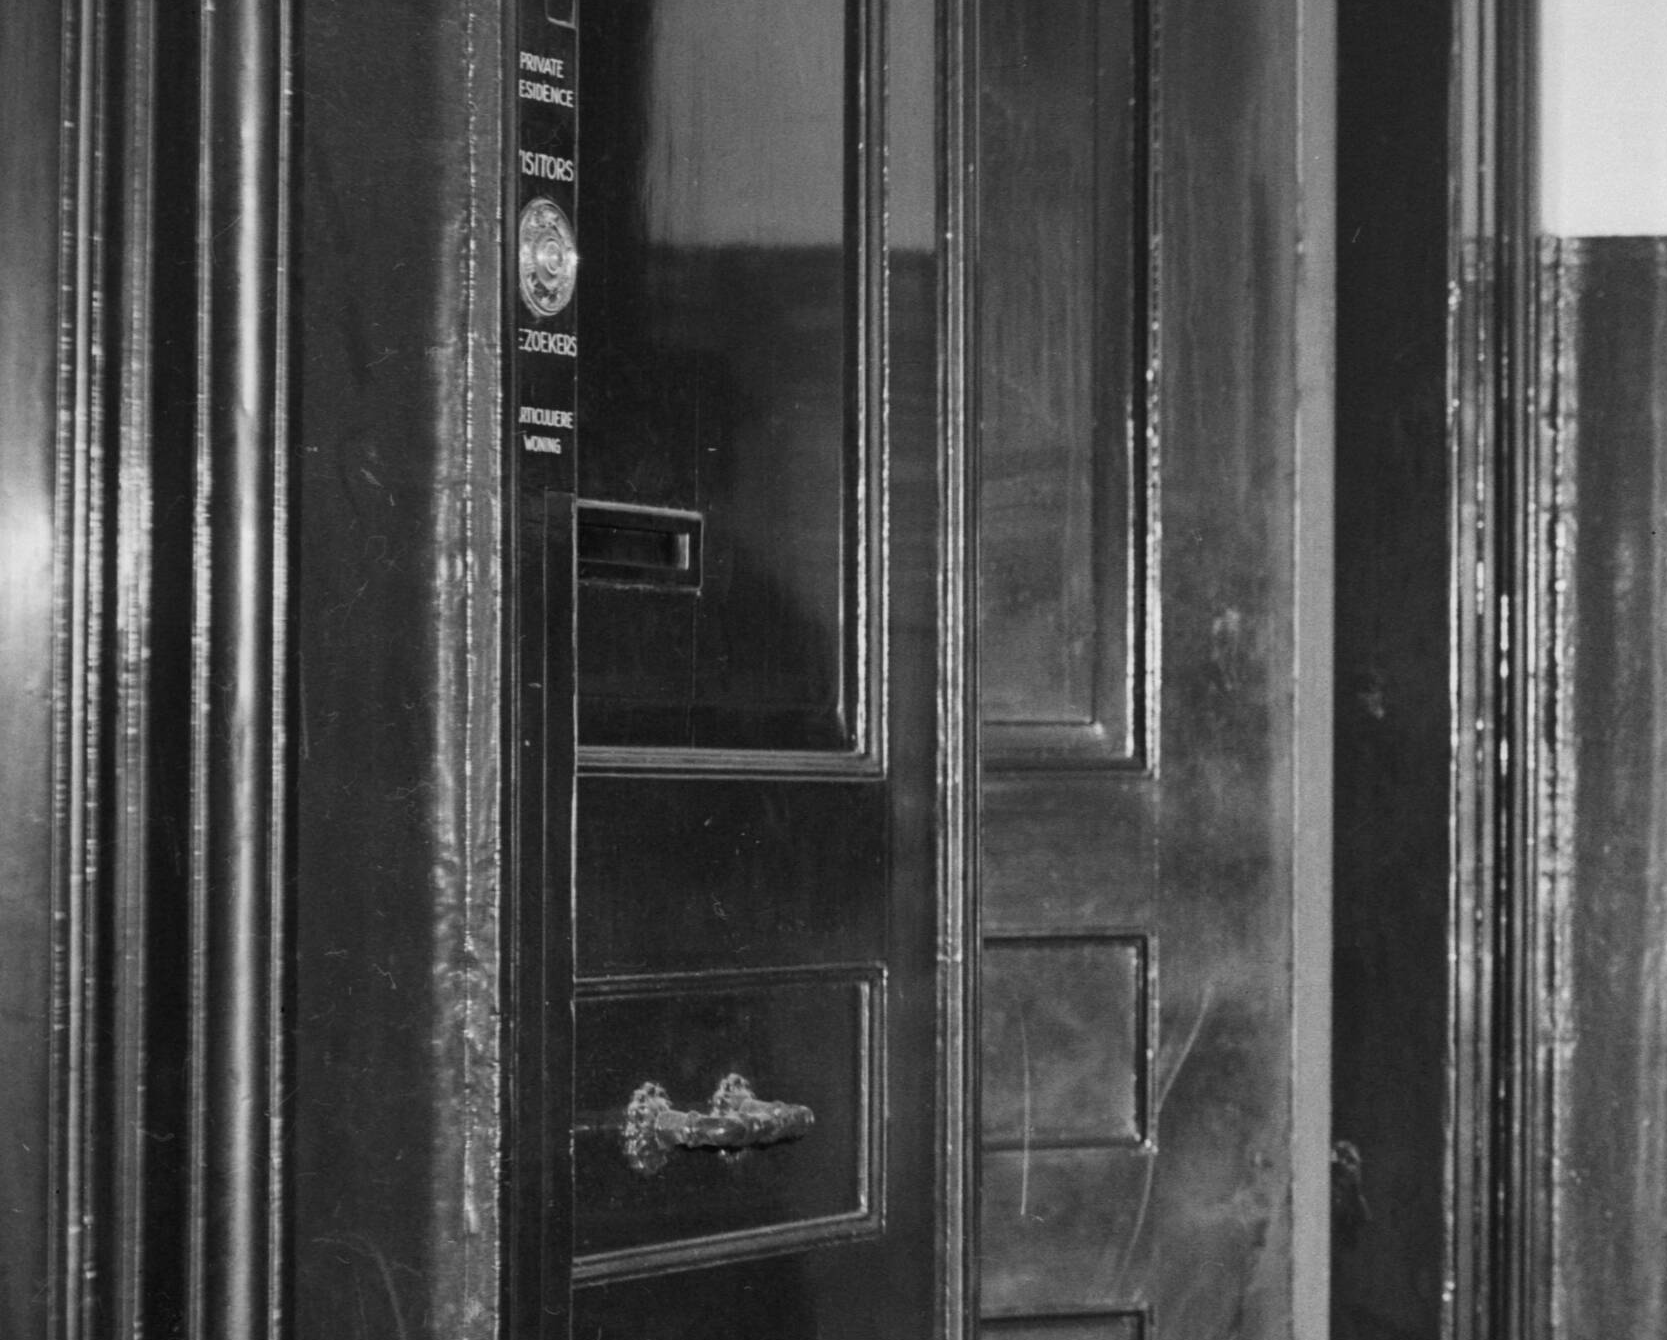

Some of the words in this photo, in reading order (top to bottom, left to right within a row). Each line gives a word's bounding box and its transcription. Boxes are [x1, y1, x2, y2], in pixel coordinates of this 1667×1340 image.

[519, 50, 565, 79] PRIVATE
[518, 77, 575, 109] ESIDENCE
[522, 433, 563, 455] WONING
